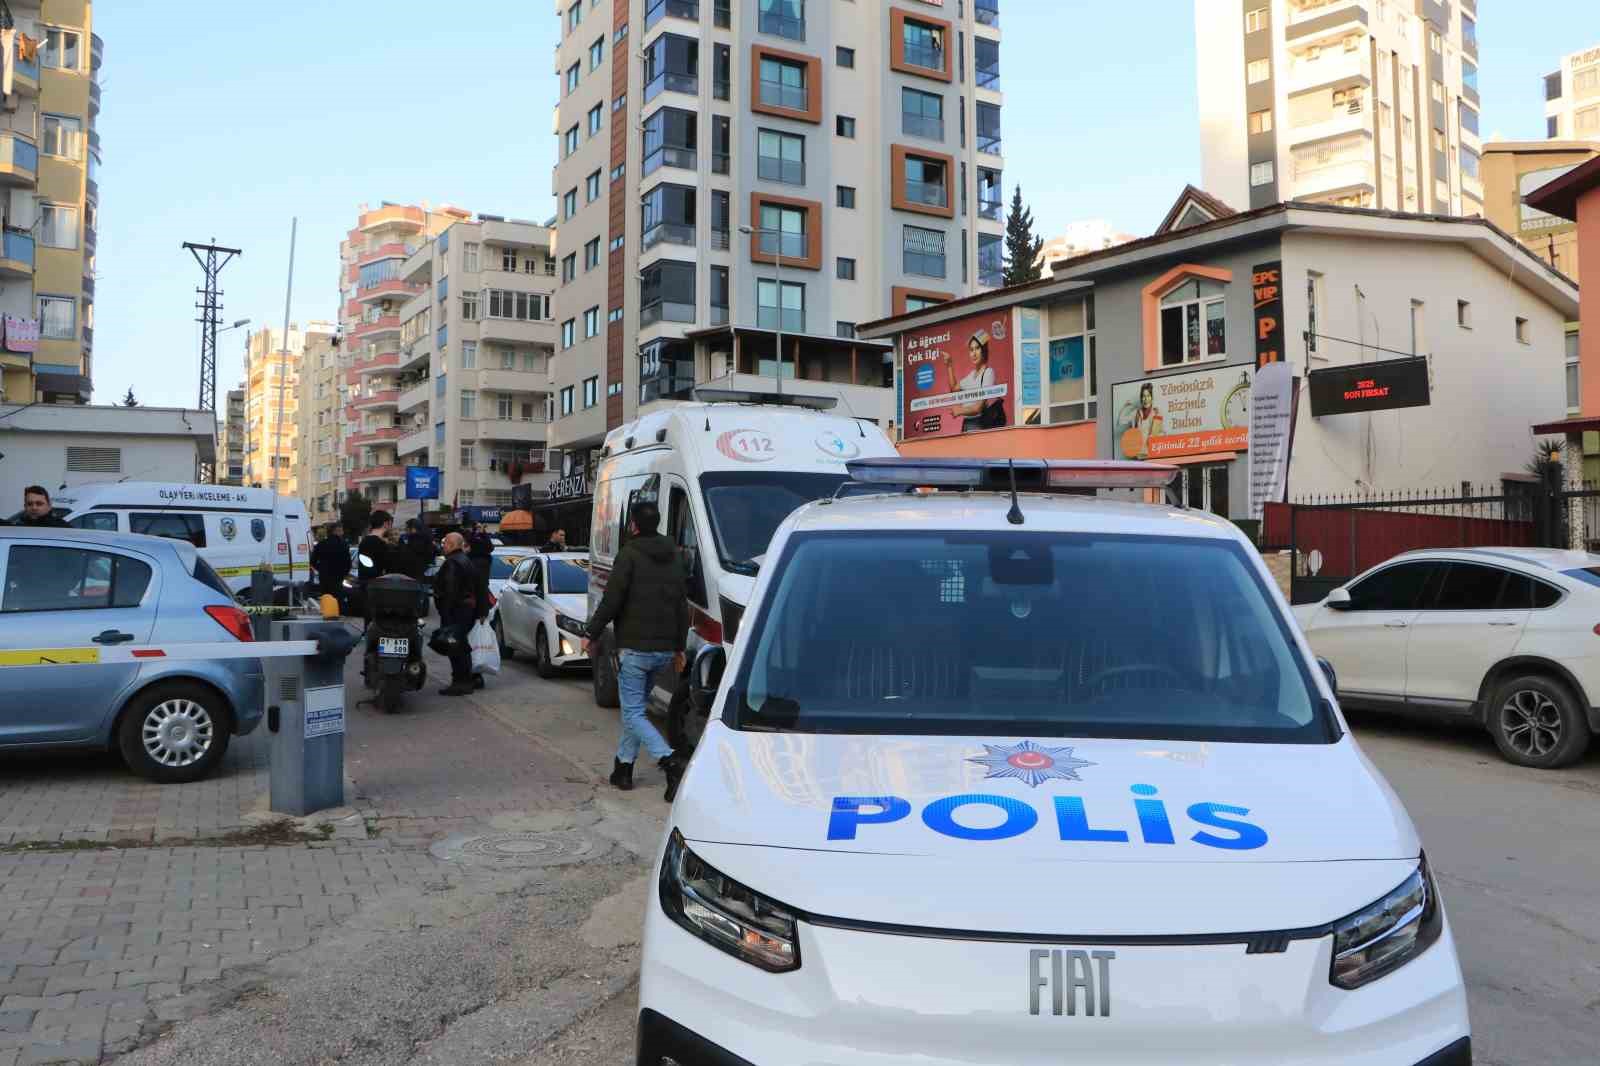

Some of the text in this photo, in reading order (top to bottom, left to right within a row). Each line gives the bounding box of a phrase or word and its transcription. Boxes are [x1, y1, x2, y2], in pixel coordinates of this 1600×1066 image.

[738, 437, 775, 452] 112
[159, 489, 178, 500] OLAY
[826, 783, 1269, 851] POLİS
[1029, 949, 1116, 1017] FIAT
